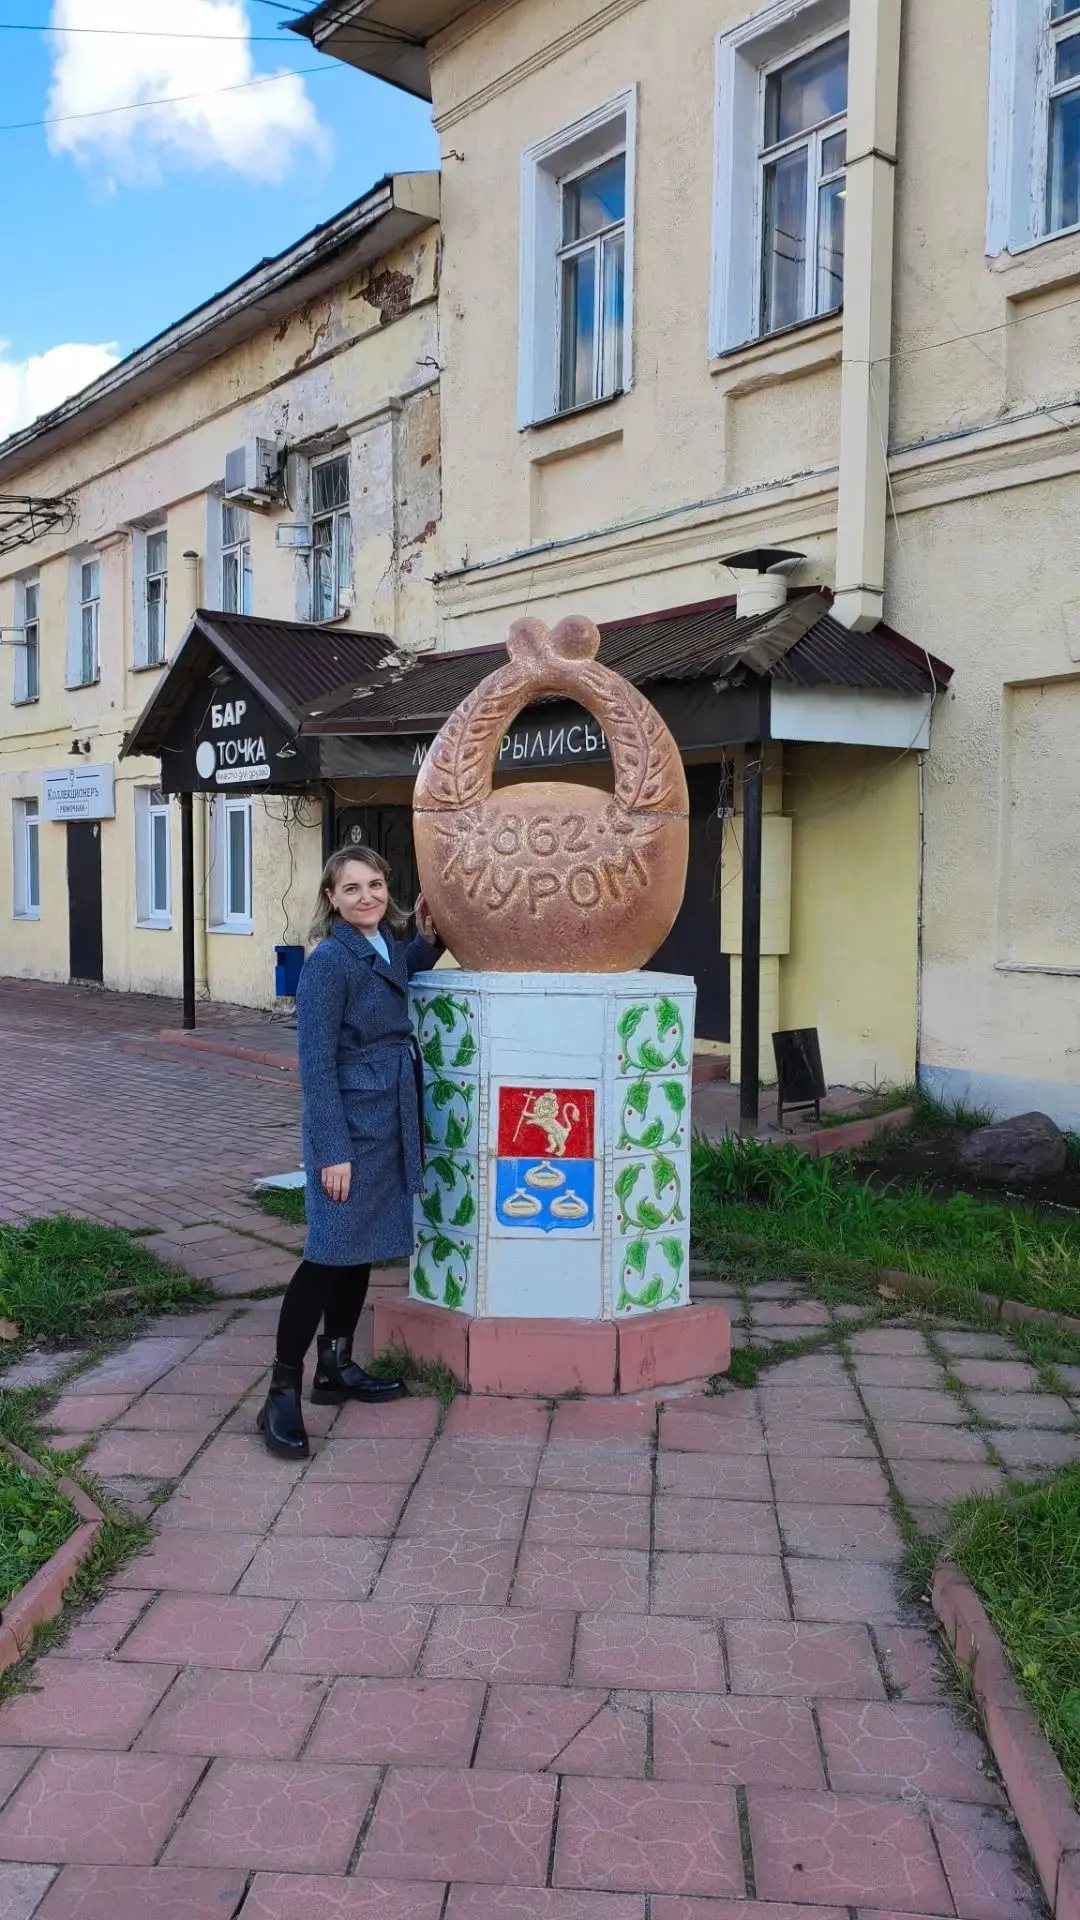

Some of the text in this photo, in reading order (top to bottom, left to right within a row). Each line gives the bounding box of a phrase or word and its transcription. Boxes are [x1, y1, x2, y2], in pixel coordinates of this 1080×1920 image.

[211, 700, 247, 729] БАР
[217, 736, 266, 766] ТОЧКА
[499, 723, 607, 761] РЫЛИСЬ!
[491, 814, 593, 856] 862
[443, 846, 649, 915] МУРОМ
